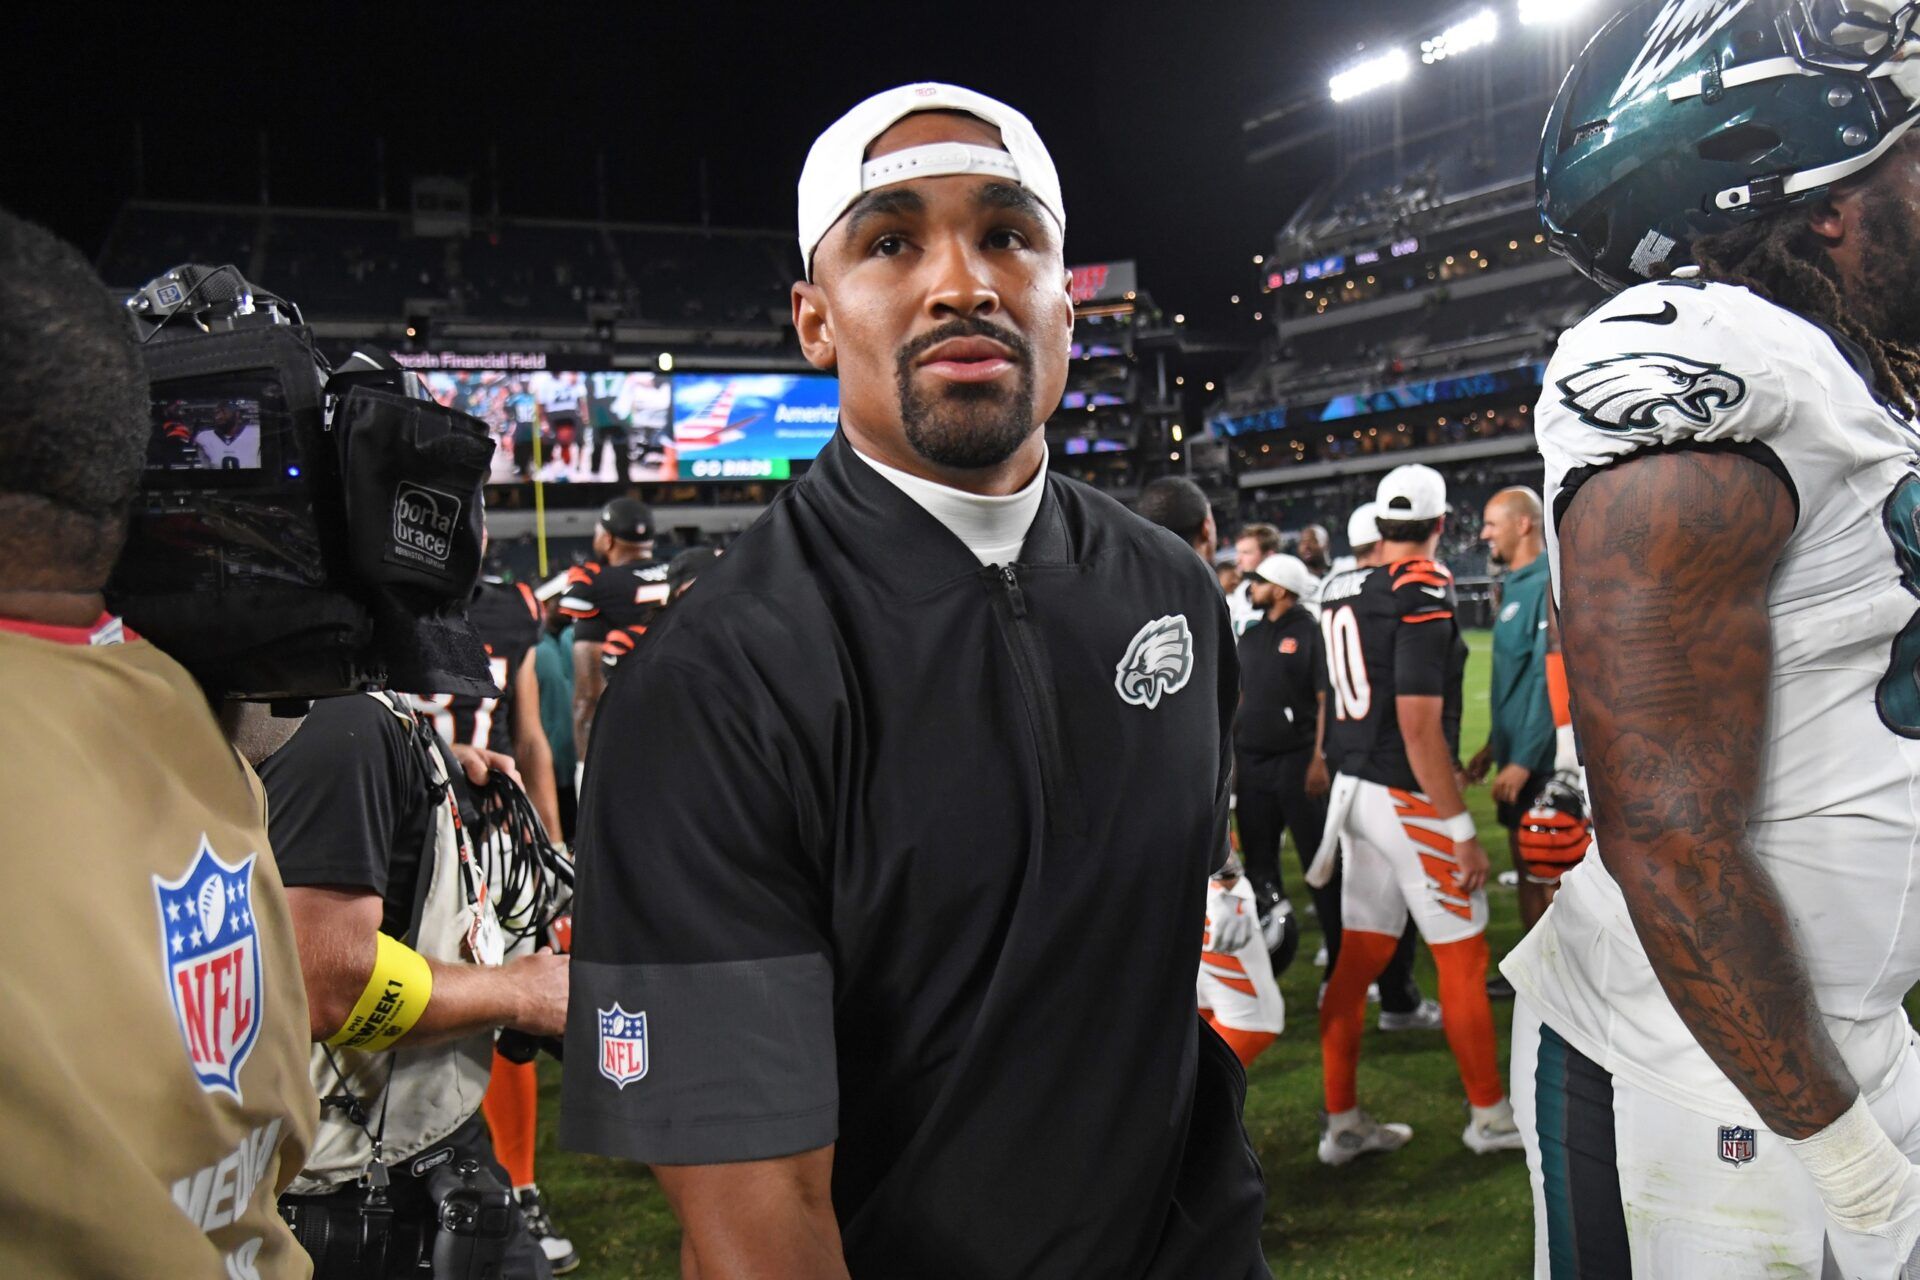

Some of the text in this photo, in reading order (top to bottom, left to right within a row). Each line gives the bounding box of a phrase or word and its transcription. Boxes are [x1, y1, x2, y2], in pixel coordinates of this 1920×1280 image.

[390, 352, 547, 369] incoln Financial Field
[774, 403, 839, 423] Americ
[692, 459, 772, 477] GO BIRDS
[397, 521, 447, 556] brace
[1321, 605, 1371, 721] 10
[178, 947, 252, 1065] NFL
[605, 1040, 640, 1076] NFL
[1724, 1141, 1751, 1159] NFL
